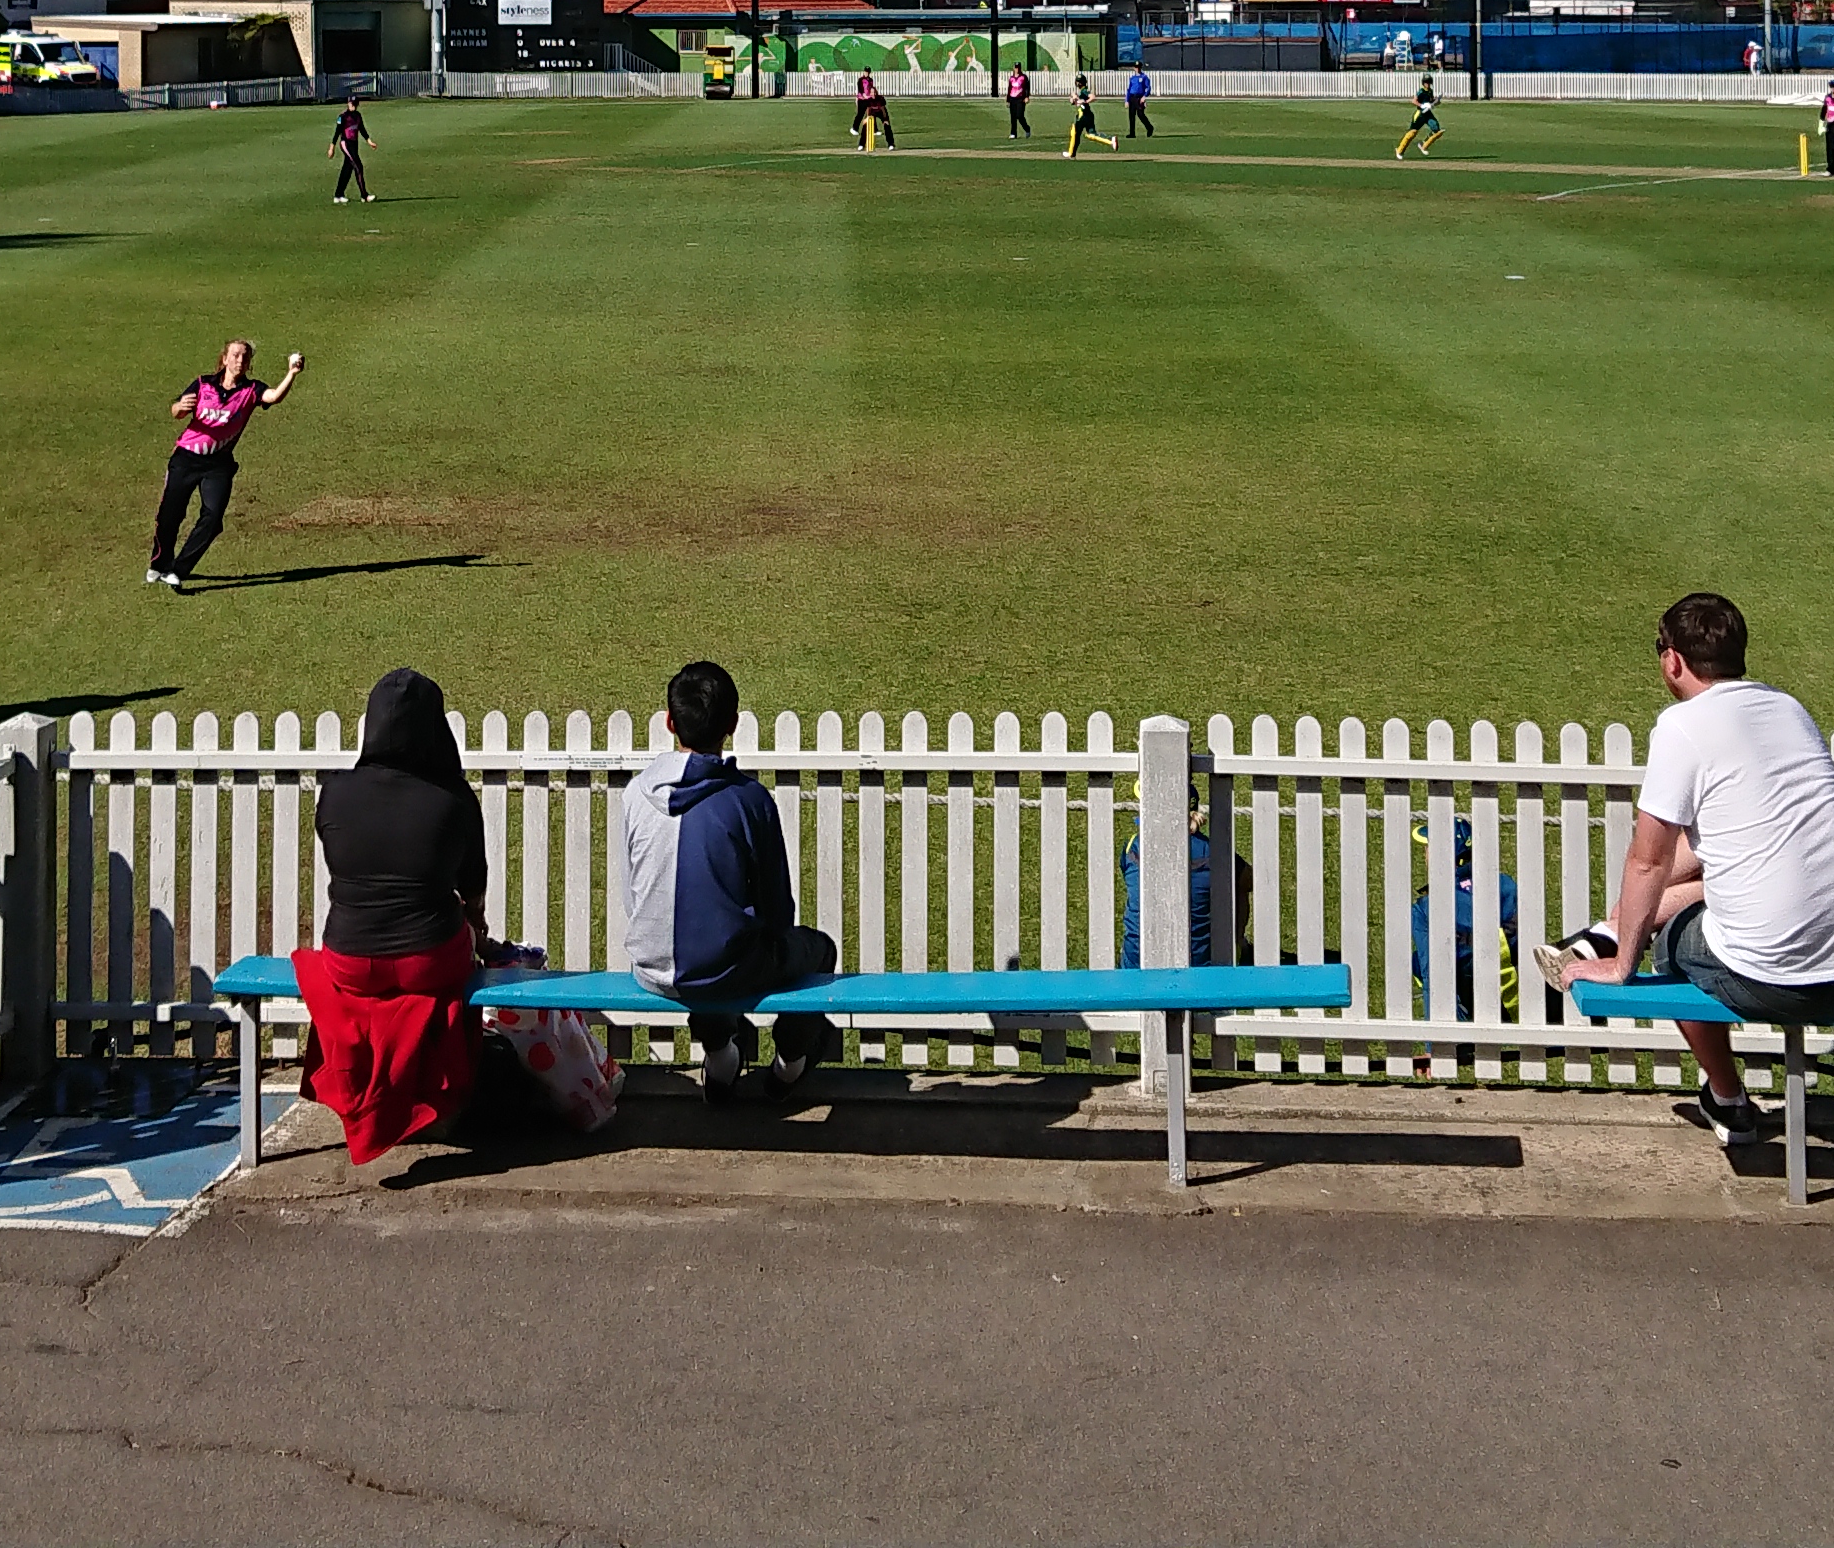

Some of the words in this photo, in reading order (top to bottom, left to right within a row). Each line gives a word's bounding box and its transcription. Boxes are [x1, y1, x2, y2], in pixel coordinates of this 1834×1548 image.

[500, 4, 550, 17] styleness
[539, 38, 565, 47] OVER
[539, 59, 582, 68] WICKETS
[198, 407, 232, 424] ANZ
